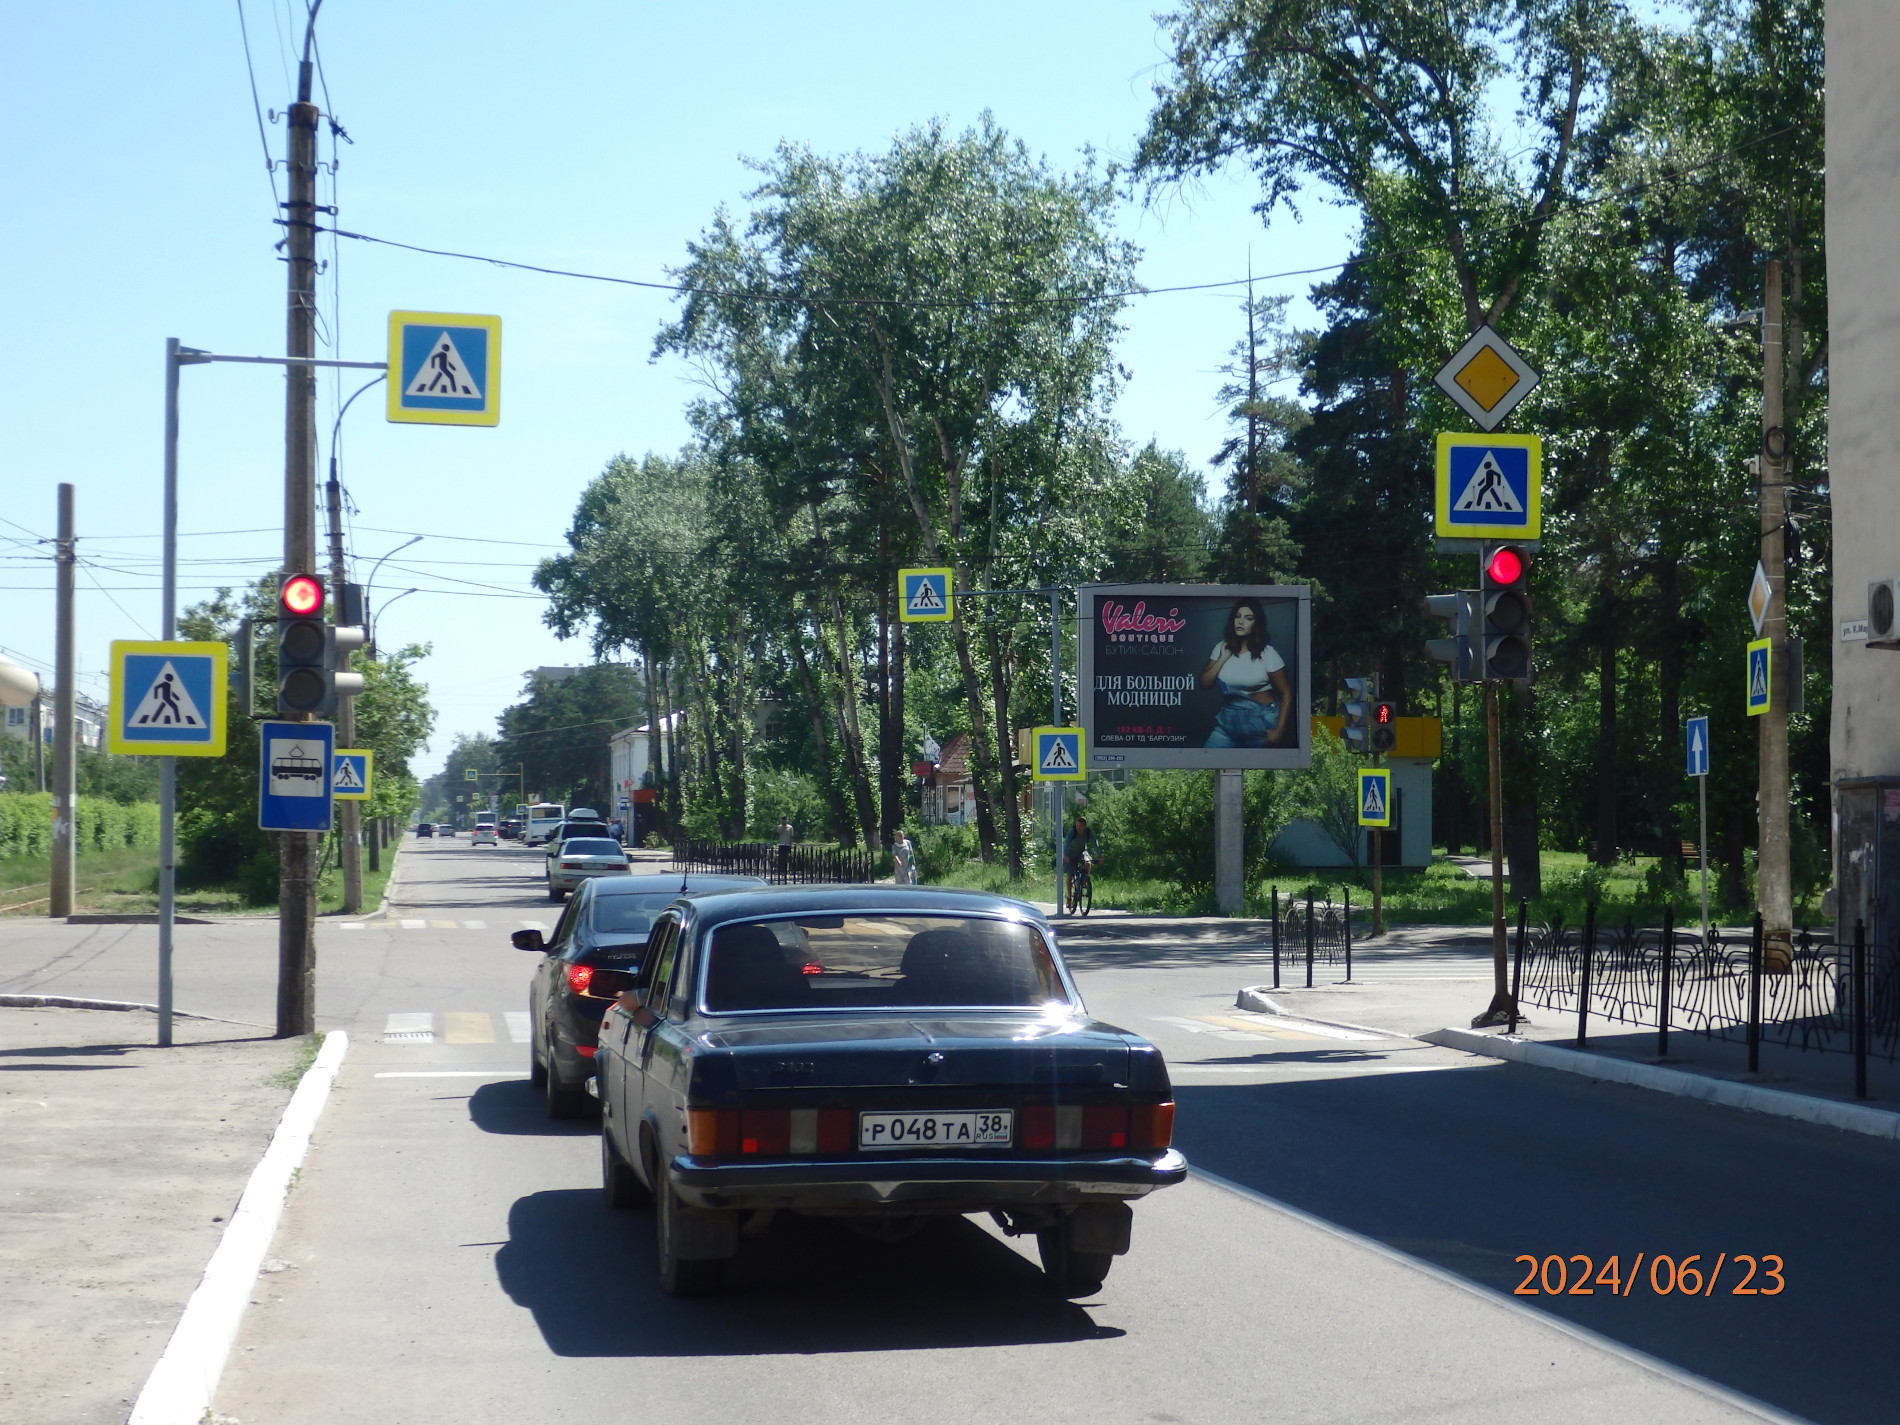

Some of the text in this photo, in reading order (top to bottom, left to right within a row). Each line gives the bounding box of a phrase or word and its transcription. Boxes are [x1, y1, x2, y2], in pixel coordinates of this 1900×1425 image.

[1102, 600, 1186, 634] Valeri
[1110, 634, 1174, 643] BOUTIQUE
[1105, 645, 1184, 656] БУТИК-САЛОН
[1095, 673, 1195, 691] ДЛЯ БОЛЬШОЙ
[1107, 691, 1182, 708] МОДНИЦЫ
[979, 1115, 1002, 1133] 38
